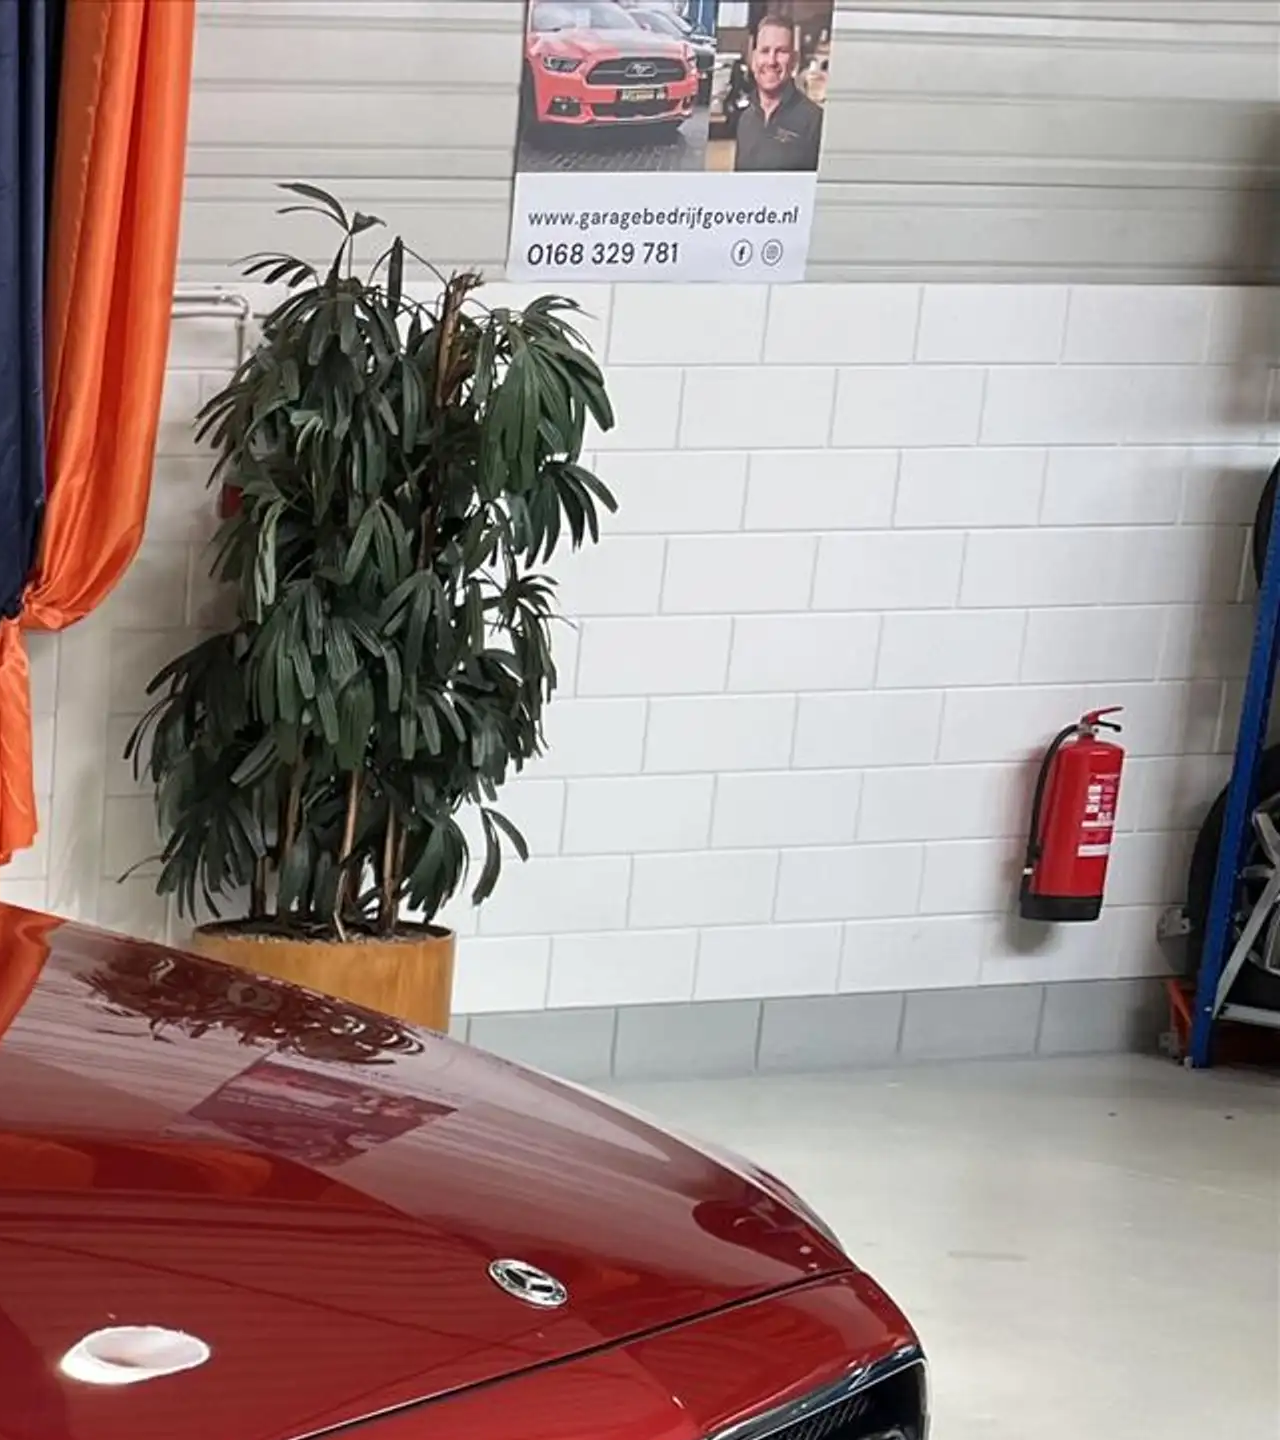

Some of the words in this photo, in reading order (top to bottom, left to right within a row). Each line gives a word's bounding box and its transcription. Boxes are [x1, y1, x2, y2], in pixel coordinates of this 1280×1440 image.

[528, 206, 798, 229] www.garagebedrijfgoverde.nl
[528, 243, 584, 265] 0168
[592, 243, 634, 264] 329
[643, 242, 677, 263] 781
